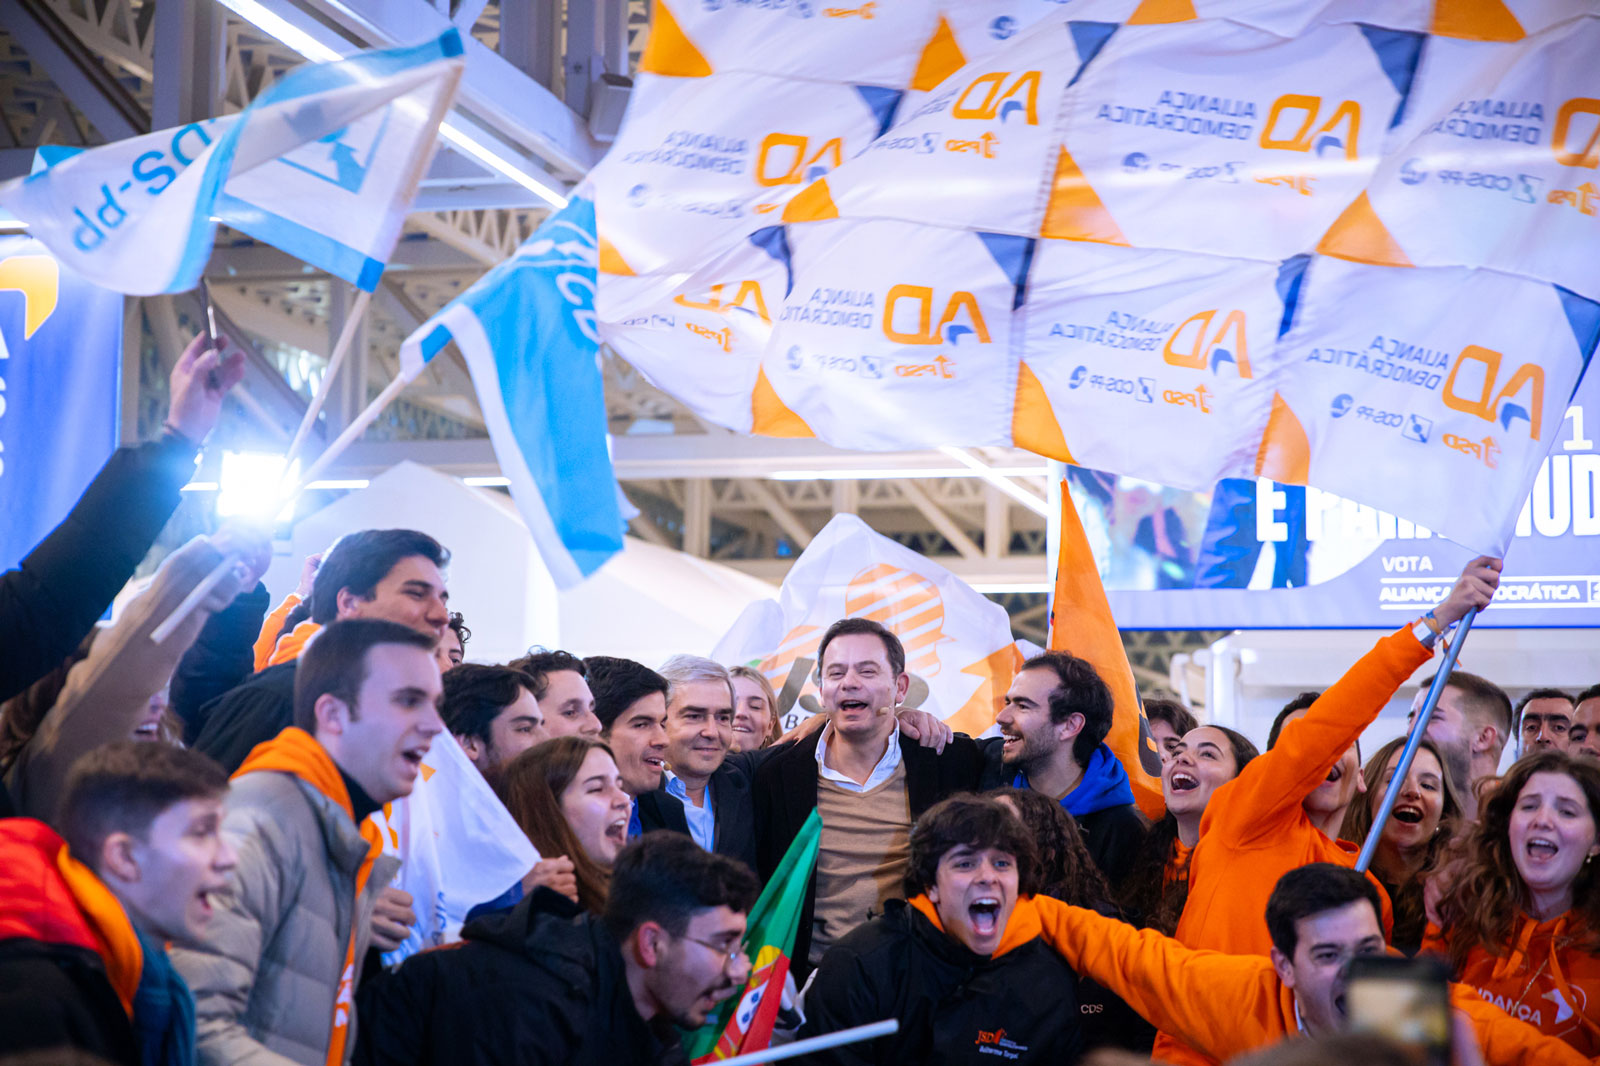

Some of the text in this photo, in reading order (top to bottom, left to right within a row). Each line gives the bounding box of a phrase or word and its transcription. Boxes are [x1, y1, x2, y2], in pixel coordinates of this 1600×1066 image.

[72, 120, 216, 252] DS-PP
[1381, 556, 1433, 572] VOTA
[1080, 1004, 1104, 1014] CDS
